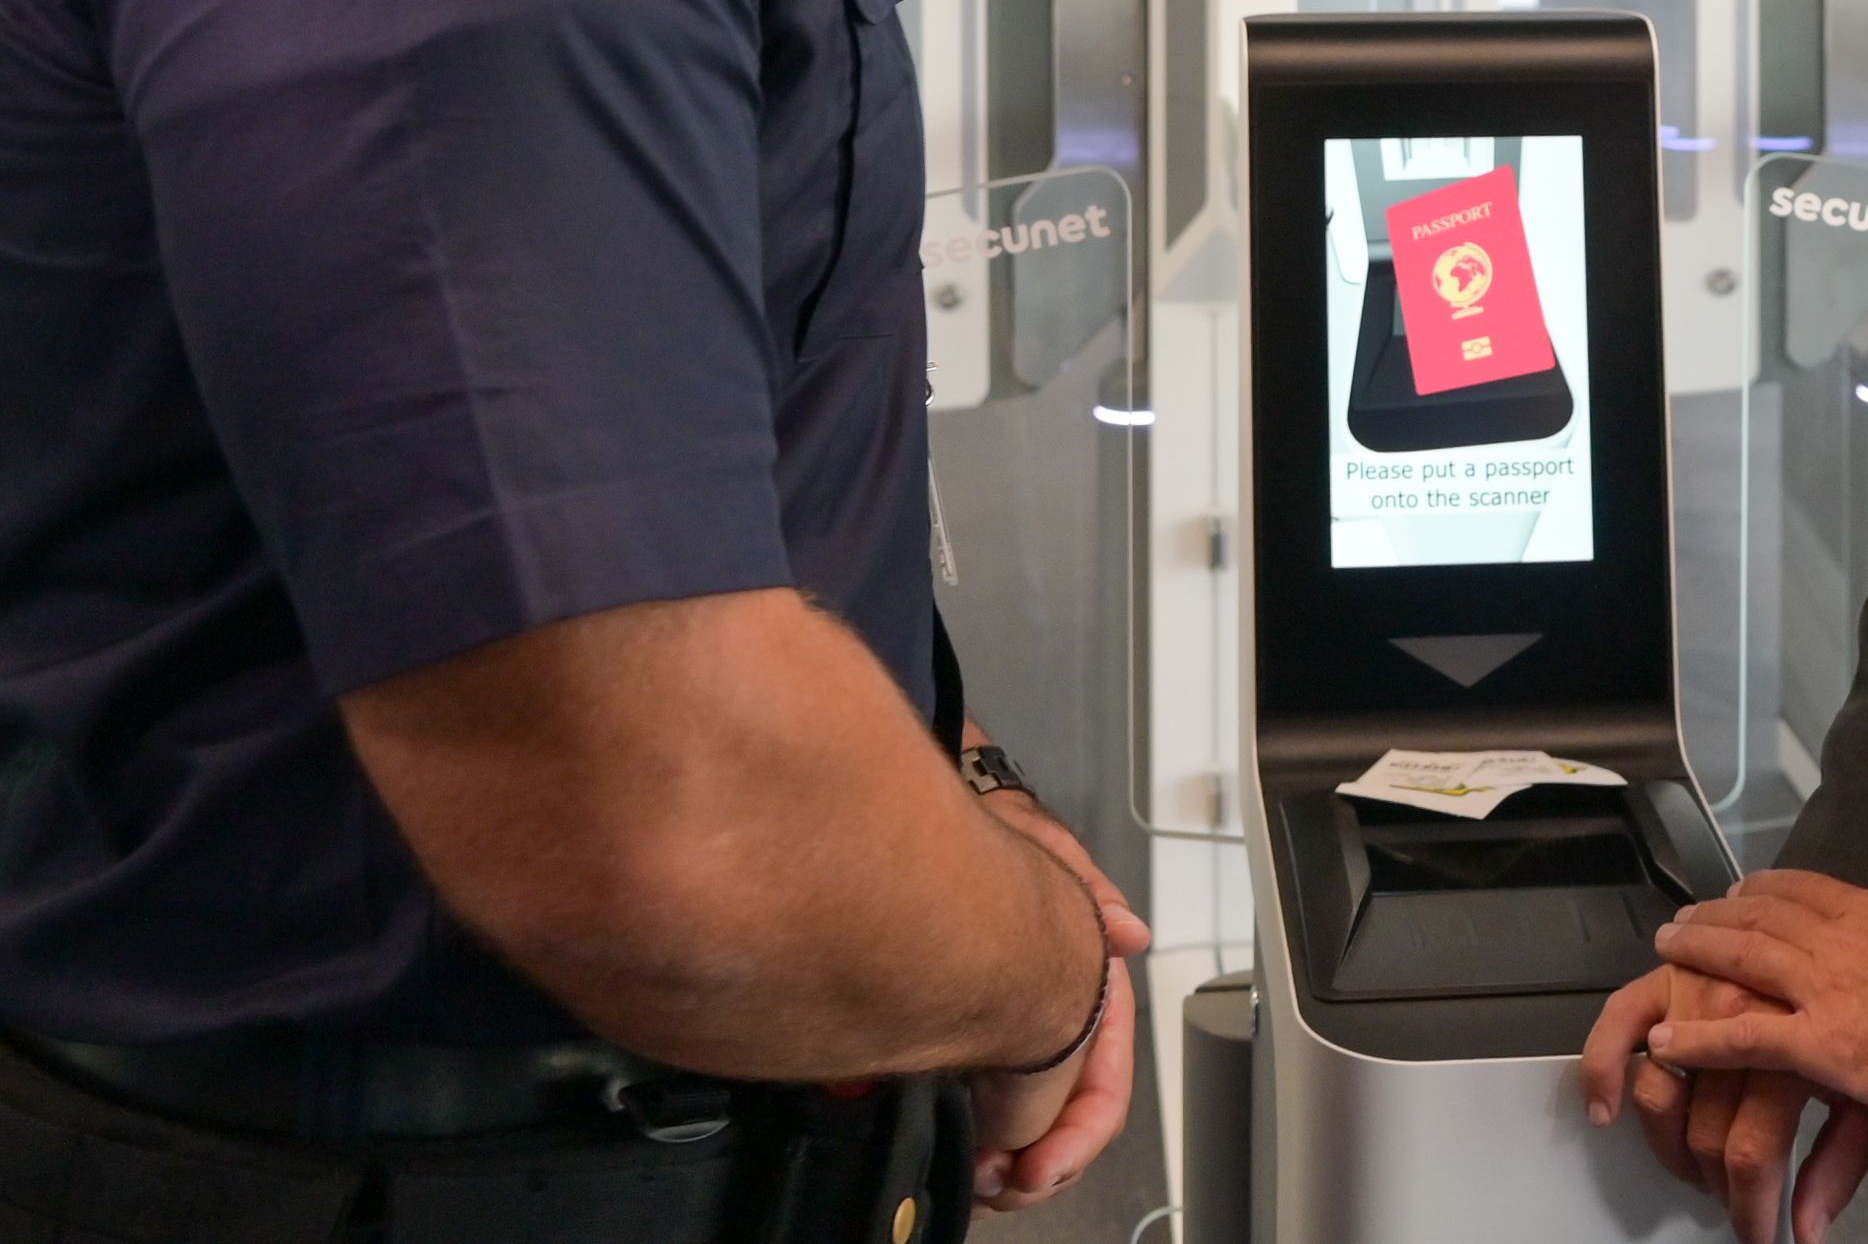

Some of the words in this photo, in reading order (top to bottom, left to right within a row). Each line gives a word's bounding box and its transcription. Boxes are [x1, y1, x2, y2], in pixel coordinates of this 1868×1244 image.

[922, 205, 1112, 268] secunet
[1412, 201, 1493, 241] PASSPORT
[1346, 462, 1413, 480] Please
[1422, 461, 1456, 482] put
[1464, 463, 1476, 477] a
[1485, 457, 1575, 481] passport
[1371, 492, 1418, 509] onto
[1427, 489, 1460, 507] the
[1469, 490, 1551, 507] scanner
